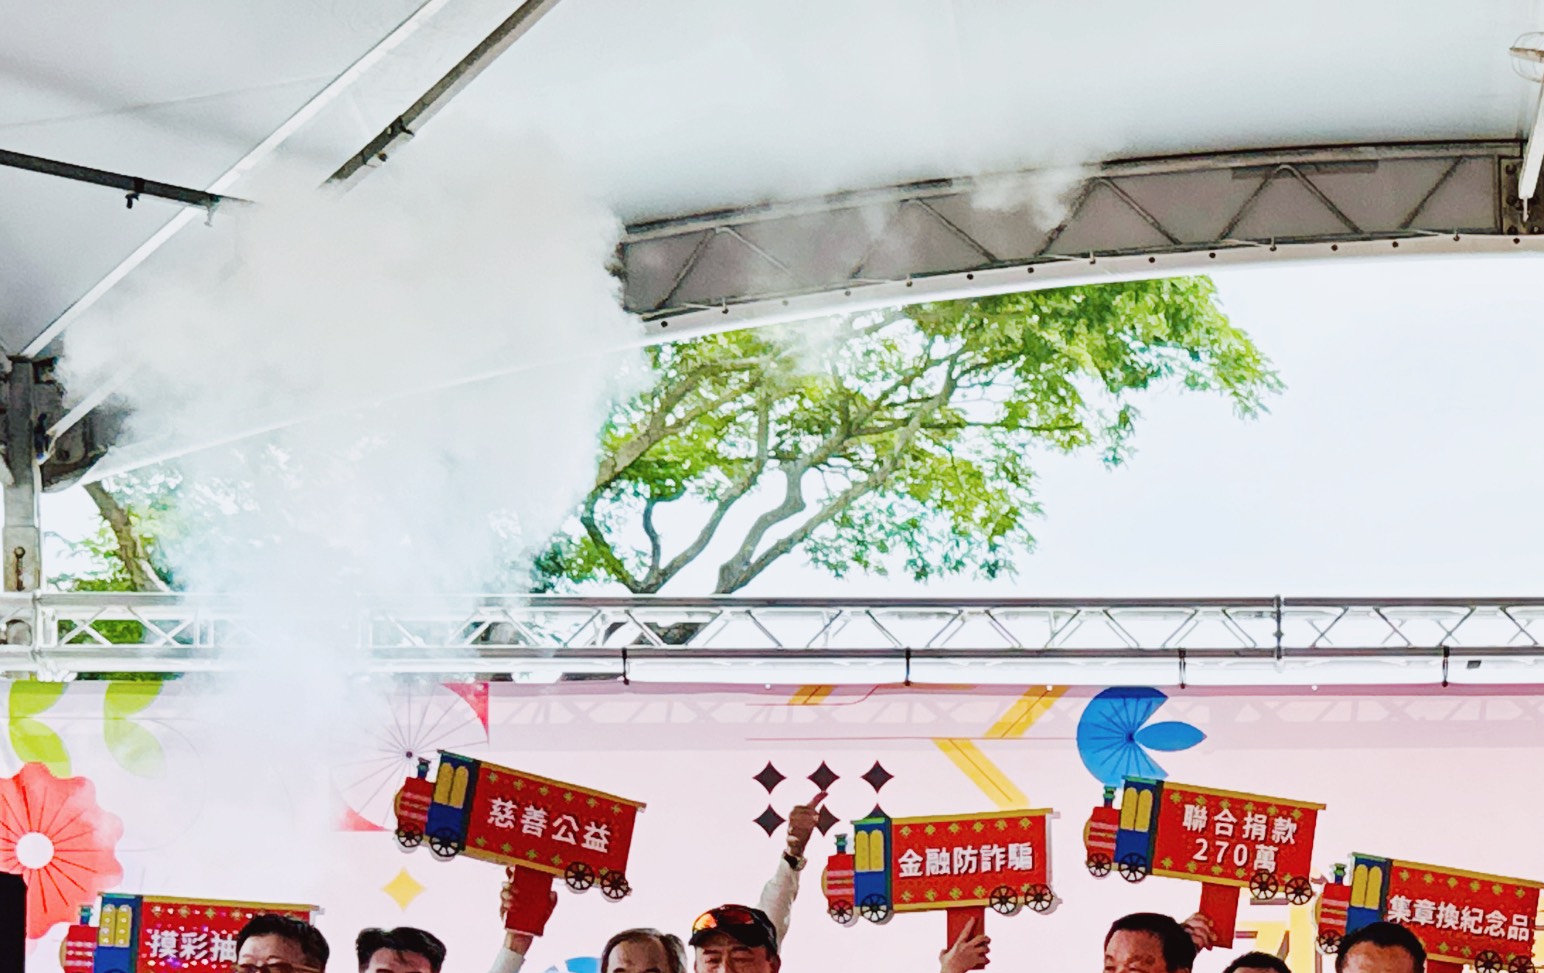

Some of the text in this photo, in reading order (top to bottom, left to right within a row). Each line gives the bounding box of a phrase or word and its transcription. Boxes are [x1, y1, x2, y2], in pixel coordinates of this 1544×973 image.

[490, 798, 609, 852] 慈善公益
[1183, 805, 1296, 843] 聯合捐款
[899, 843, 1032, 877] 金融防詐騙
[1194, 839, 1278, 873] 270萬
[1387, 896, 1529, 940] 集章換紀念品
